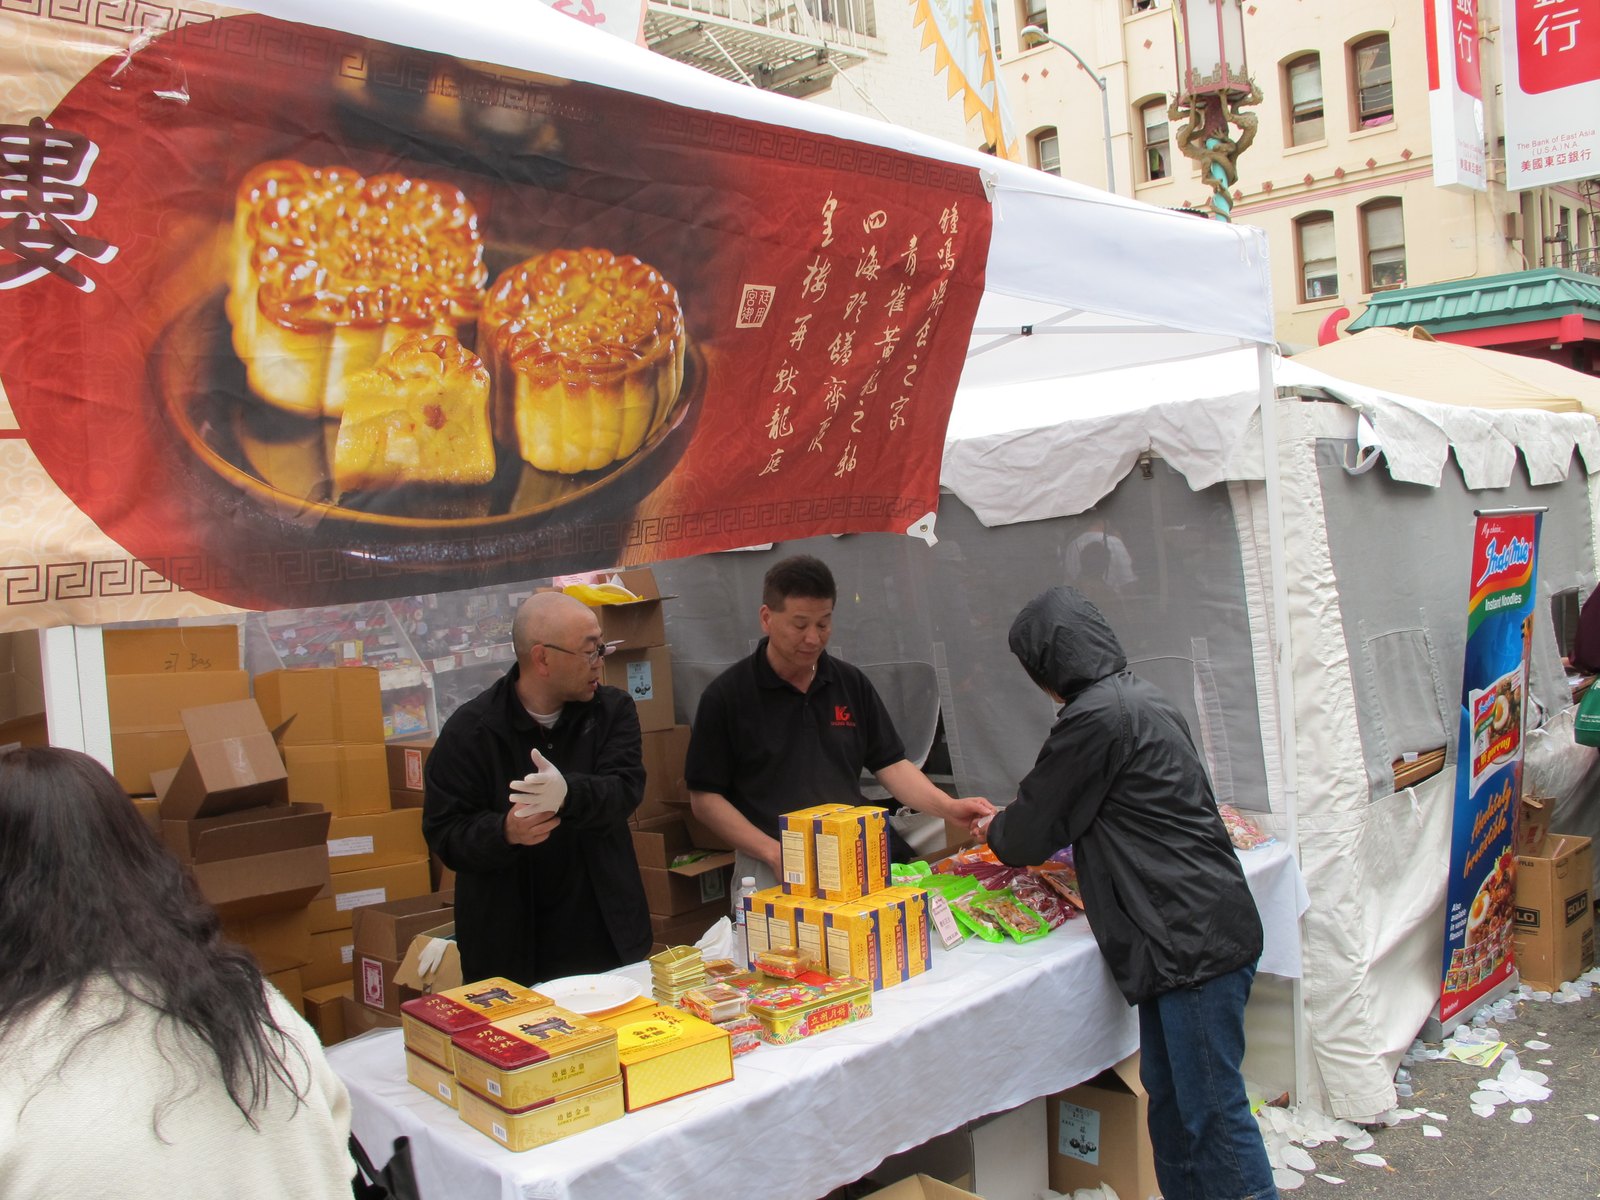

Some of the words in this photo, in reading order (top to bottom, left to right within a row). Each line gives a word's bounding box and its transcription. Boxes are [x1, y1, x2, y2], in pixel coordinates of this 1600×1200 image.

[1532, 138, 1549, 147] Bank
[1561, 132, 1577, 141] East
[1579, 129, 1596, 137] Asia
[1521, 148, 1592, 172] 美國東亞銀行
[1485, 596, 1502, 611] Instant
[1502, 592, 1522, 606] Noodles
[1567, 897, 1586, 918] SOLO
